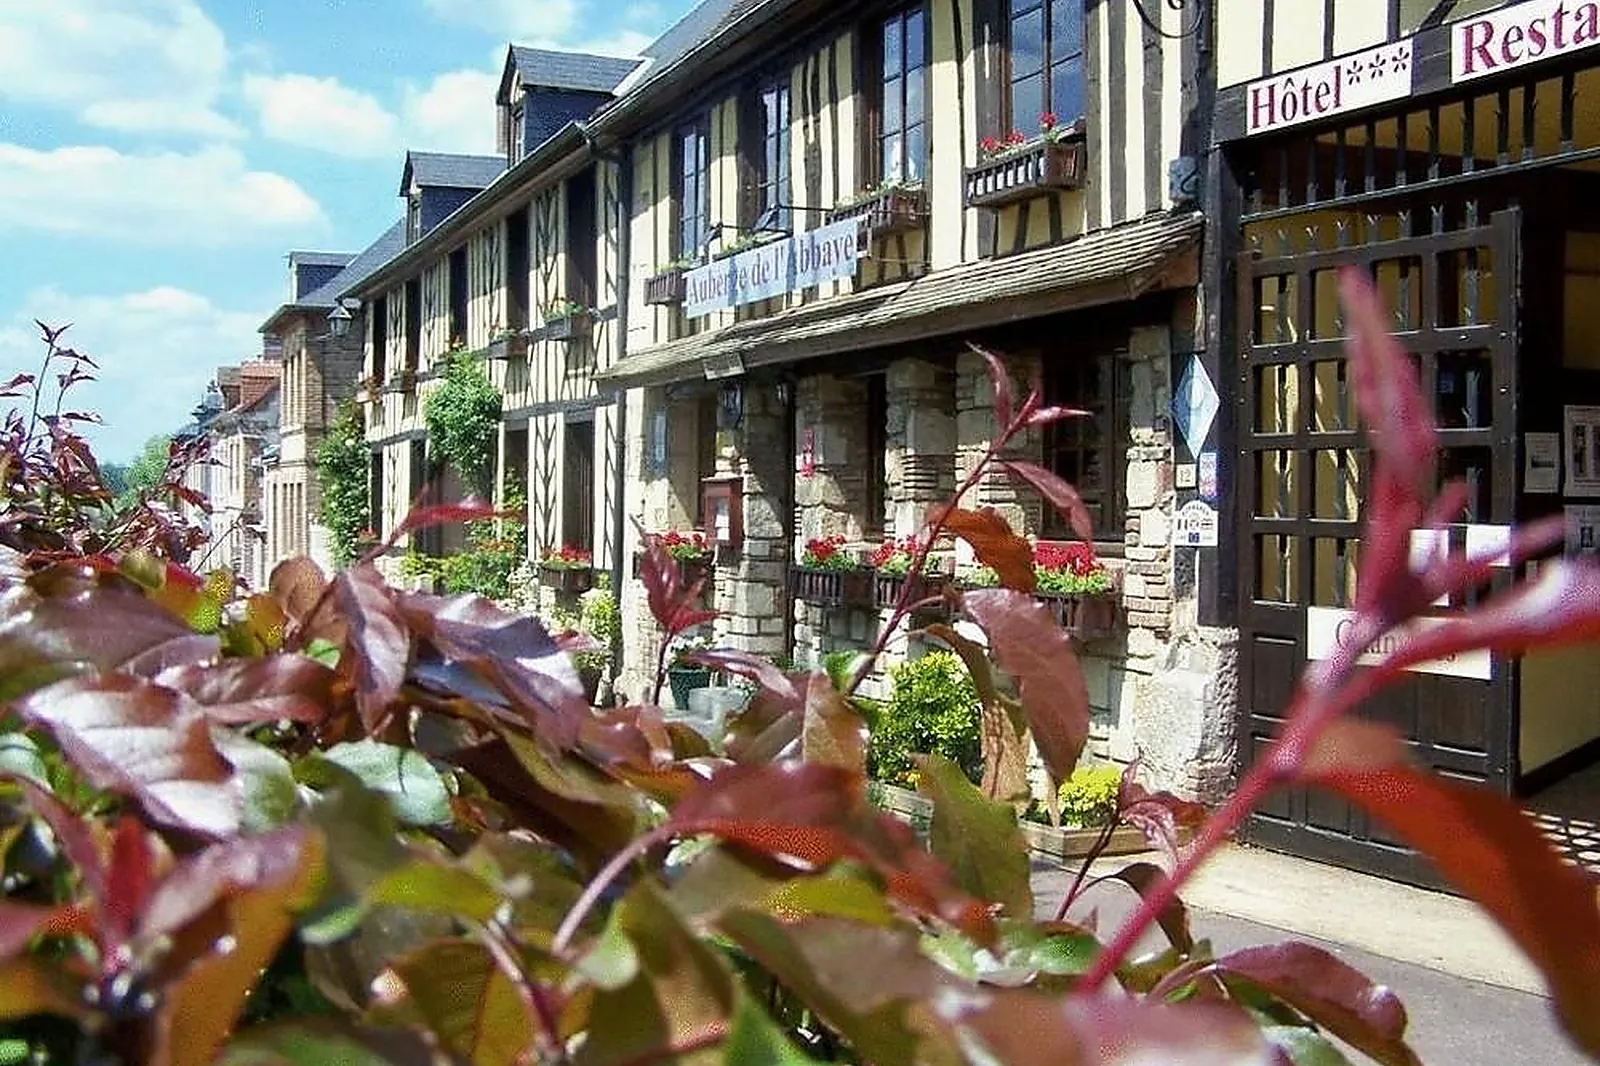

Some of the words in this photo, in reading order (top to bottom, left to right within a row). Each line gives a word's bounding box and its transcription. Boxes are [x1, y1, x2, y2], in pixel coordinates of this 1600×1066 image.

[1460, 0, 1600, 76] Resta
[1250, 65, 1343, 130] Hôtel
[751, 252, 770, 287] de
